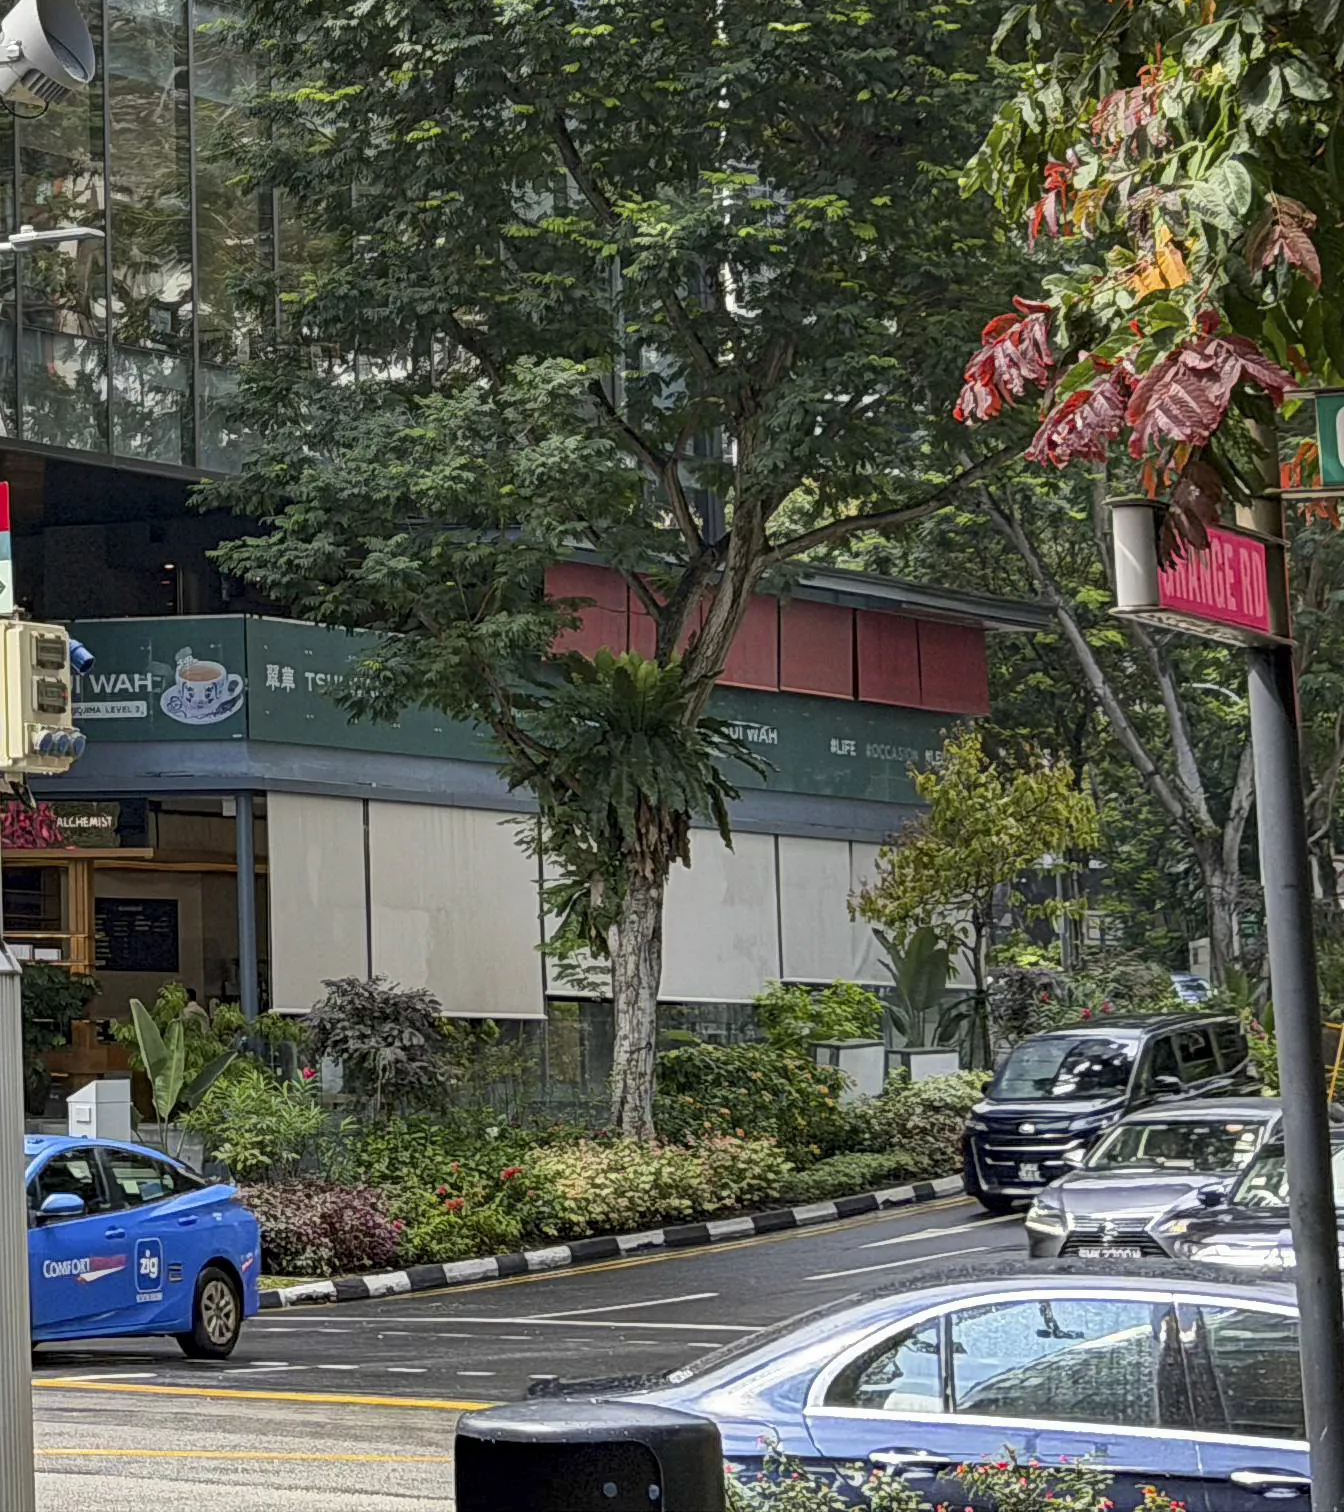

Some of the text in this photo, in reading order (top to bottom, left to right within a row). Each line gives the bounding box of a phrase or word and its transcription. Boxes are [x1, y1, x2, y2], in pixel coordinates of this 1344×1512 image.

[1239, 547, 1265, 618] RD
[89, 672, 152, 694] WAH
[746, 727, 779, 745] WAH
[830, 737, 857, 757] #LIFE
[56, 815, 113, 829] ALCHEMIST
[42, 1249, 159, 1279] COMFORT zig
